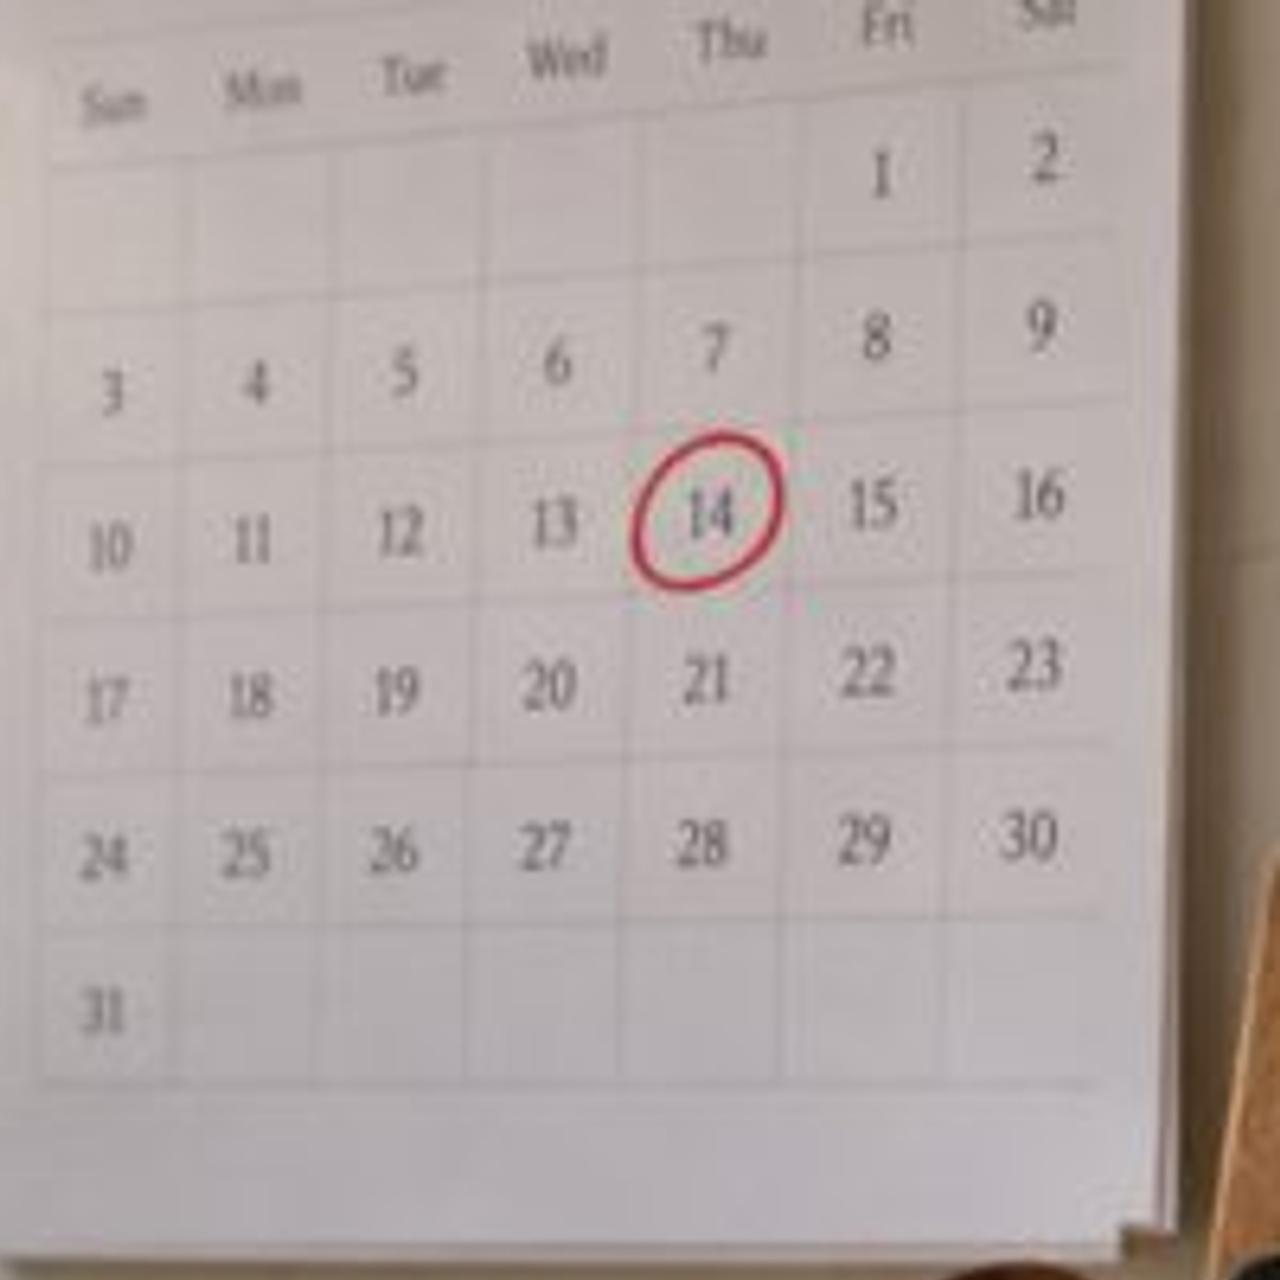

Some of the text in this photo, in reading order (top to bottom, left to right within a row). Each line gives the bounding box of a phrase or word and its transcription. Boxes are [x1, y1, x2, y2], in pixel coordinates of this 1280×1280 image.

[80, 85, 149, 126] Sun
[224, 68, 303, 109] Mon
[380, 54, 448, 97] Tue
[526, 35, 609, 80] Wed
[696, 16, 769, 62] Thu
[872, 128, 1061, 202] 1 2
[100, 297, 1059, 420] 3 4 5 6 7 8 9
[88, 468, 1068, 575] 10 11 12 13 14 15 16
[84, 635, 1065, 729] 17 18 19 20 21 22 23
[78, 807, 1061, 884] 24 25 26 27 28 29 30
[80, 984, 127, 1038] 31
